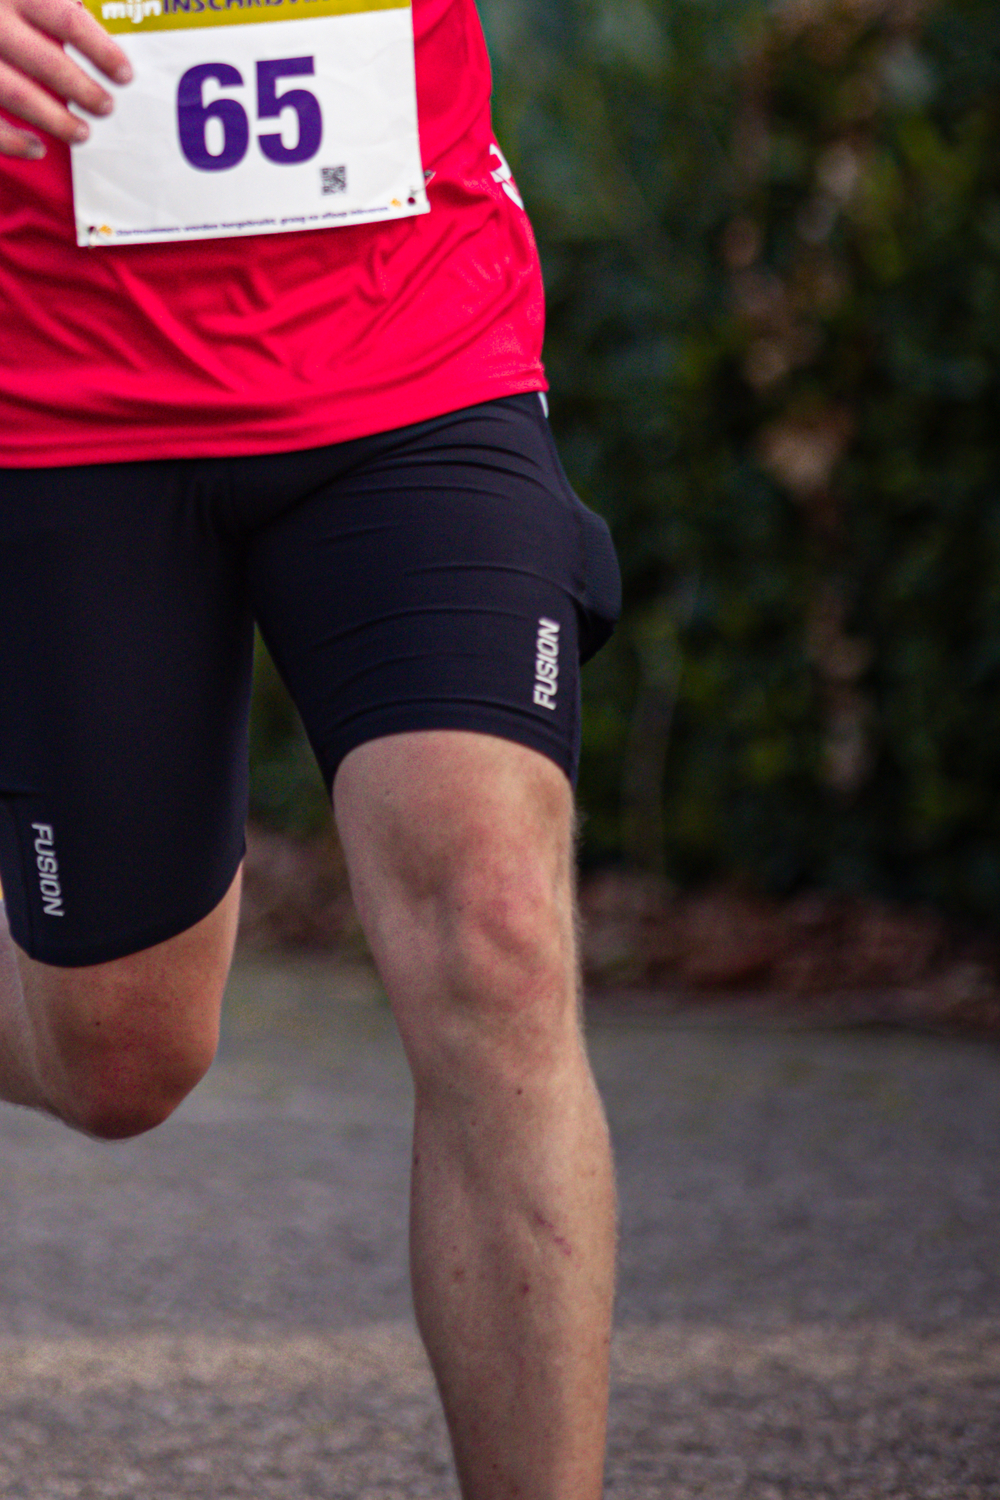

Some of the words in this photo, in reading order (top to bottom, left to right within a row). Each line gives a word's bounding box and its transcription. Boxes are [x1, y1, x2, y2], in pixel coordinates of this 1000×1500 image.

[175, 55, 324, 174] 65
[533, 617, 560, 711] FUSION
[31, 822, 65, 917] FUSION
